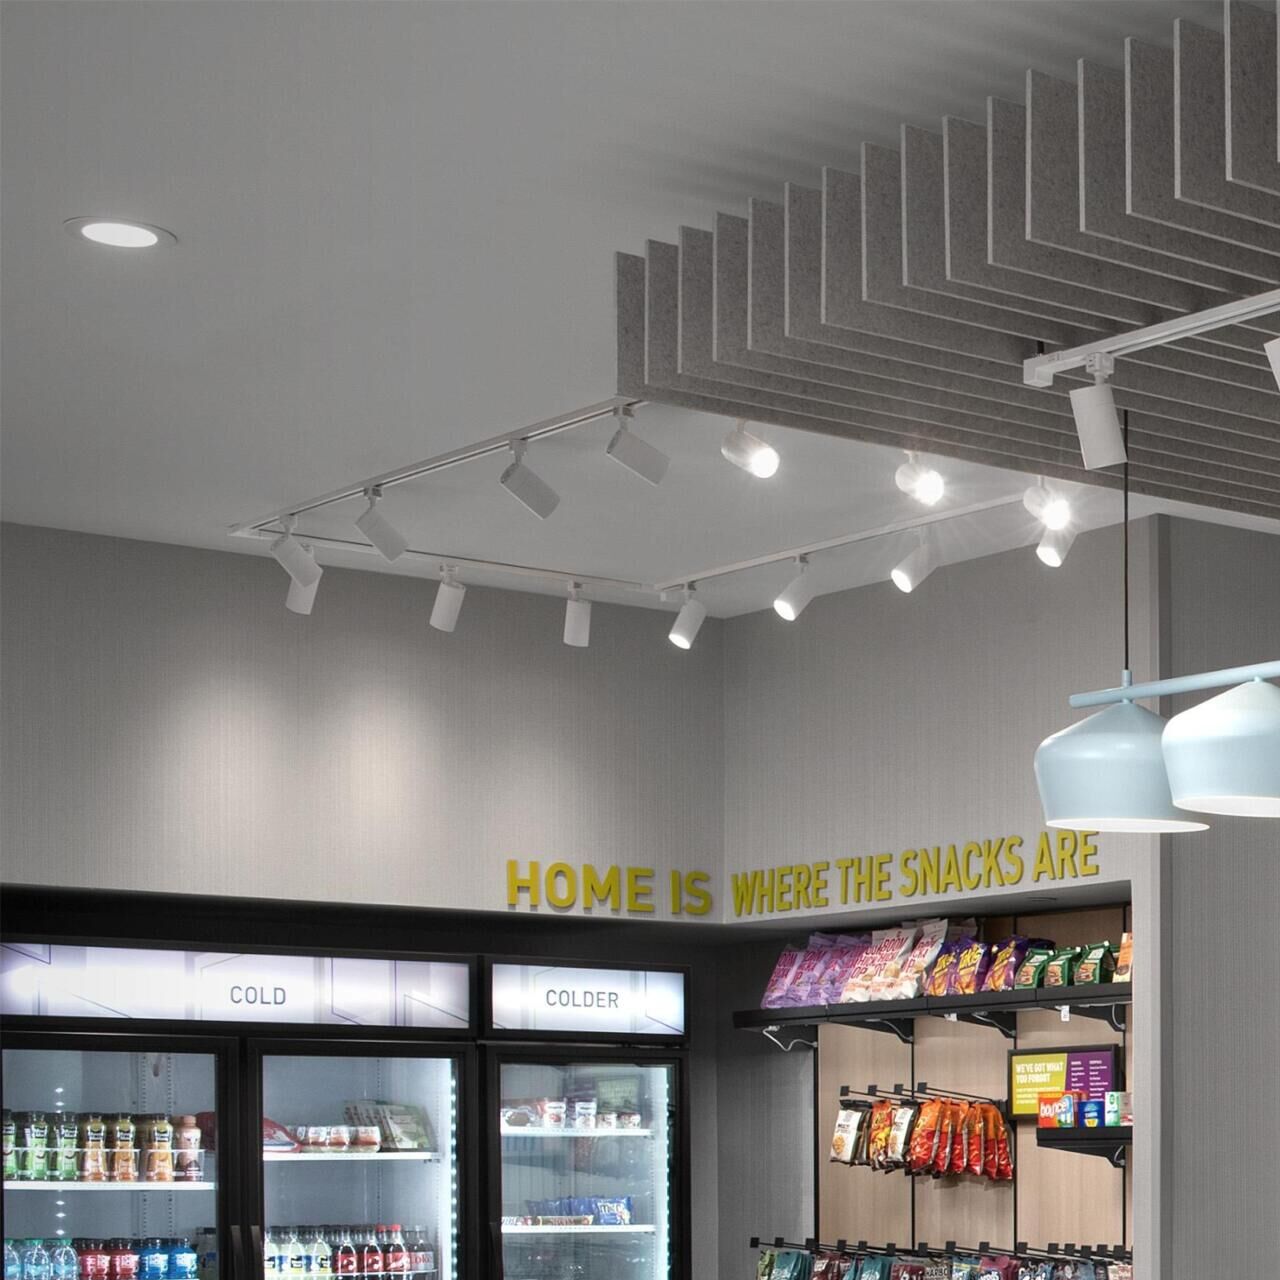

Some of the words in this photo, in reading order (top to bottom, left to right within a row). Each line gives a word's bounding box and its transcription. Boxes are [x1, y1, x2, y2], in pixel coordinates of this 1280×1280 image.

[507, 859, 655, 912] HOME
[672, 869, 712, 915] IS
[731, 861, 829, 917] WHERE
[835, 853, 893, 905] THE
[900, 835, 1024, 897] SNACKS
[1033, 830, 1099, 882] ARE
[230, 985, 287, 1005] COLD
[546, 989, 619, 1009] COLDER
